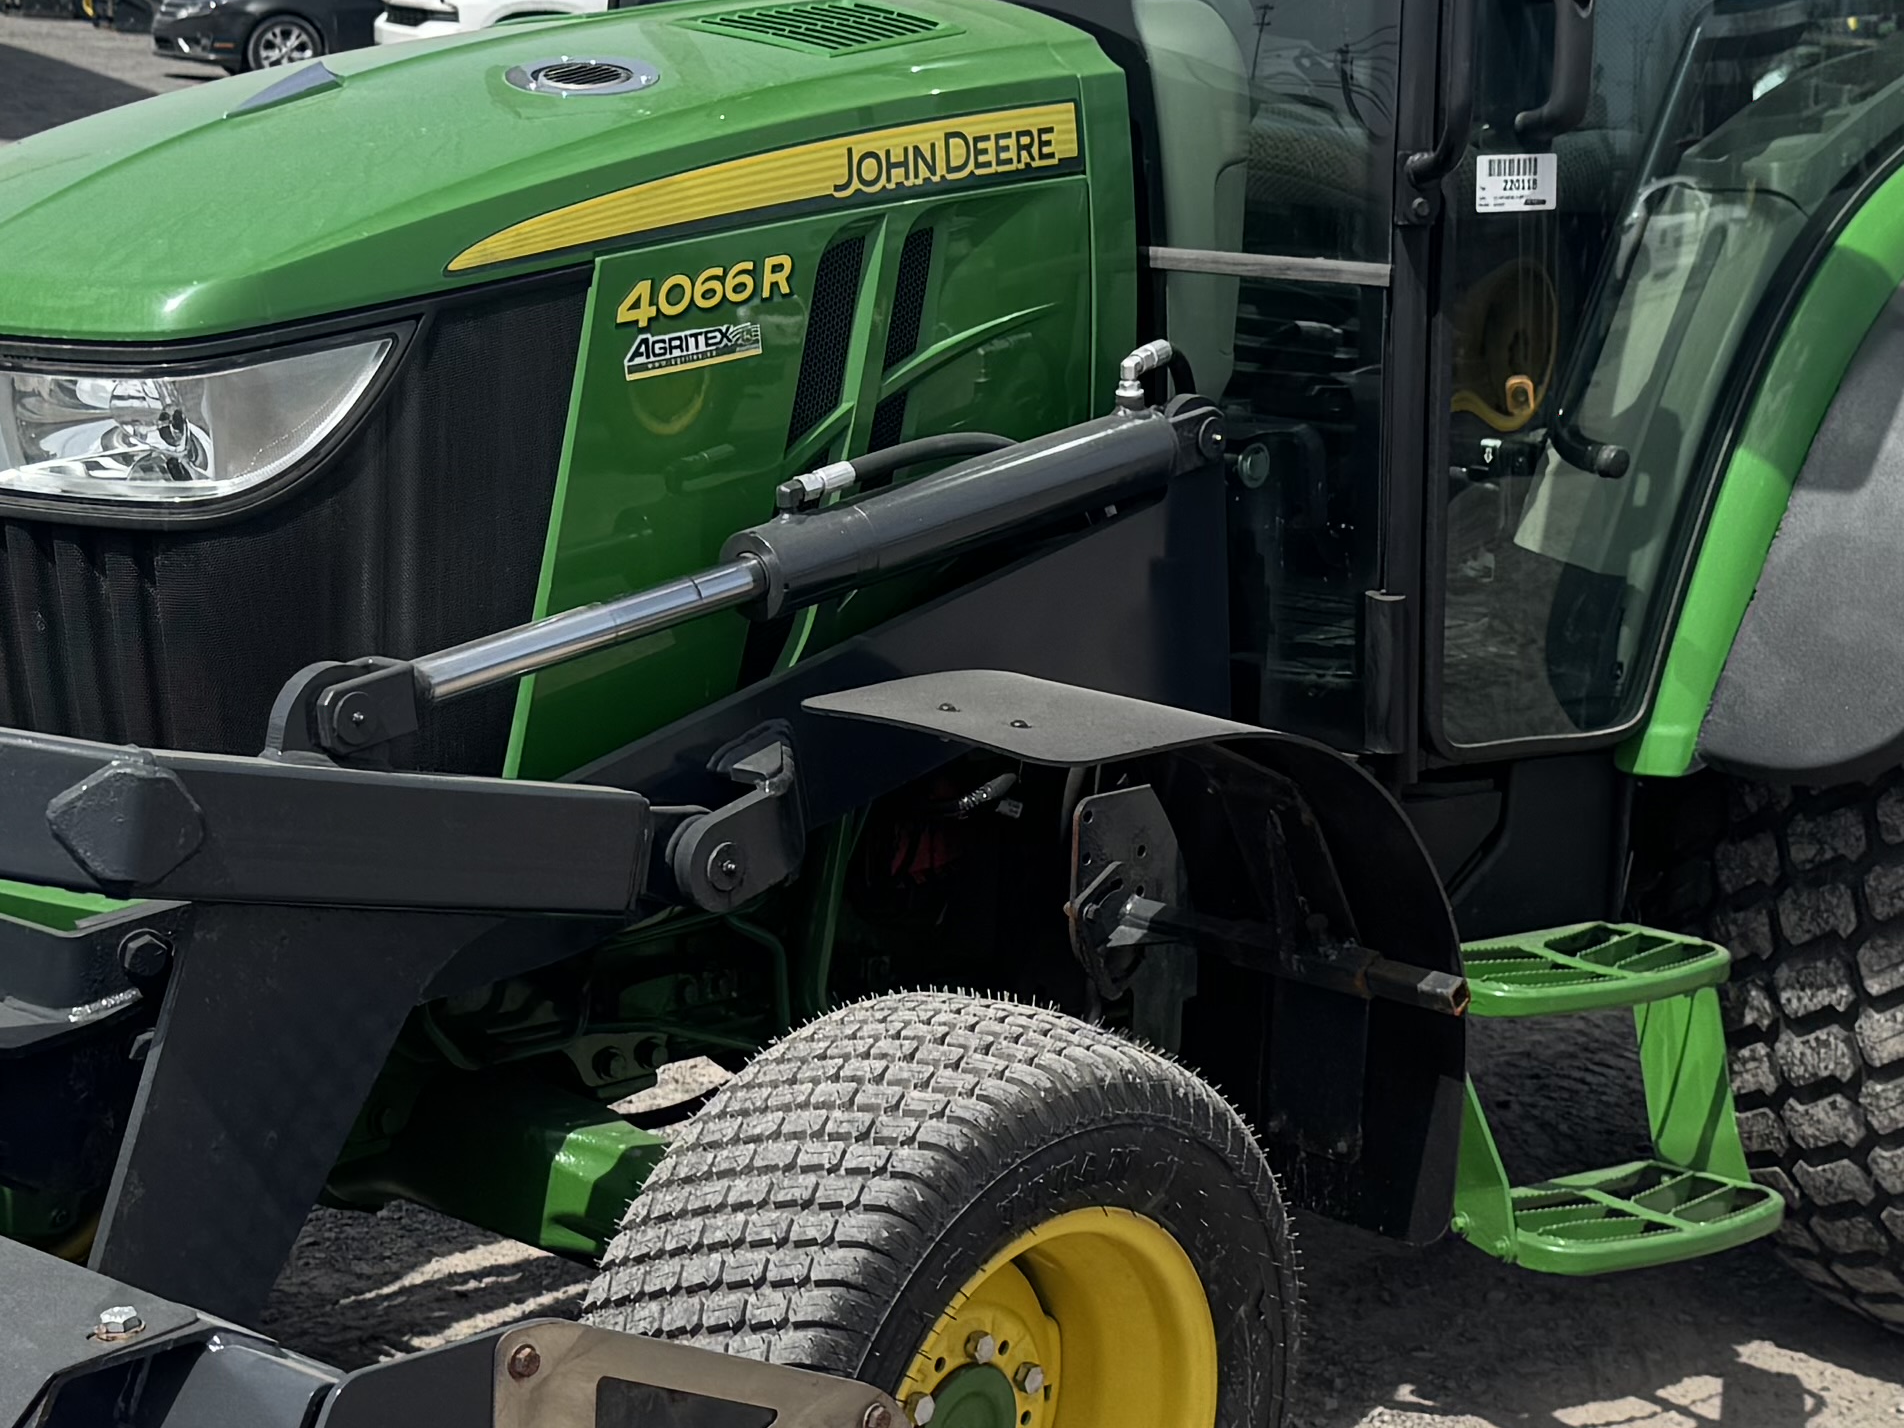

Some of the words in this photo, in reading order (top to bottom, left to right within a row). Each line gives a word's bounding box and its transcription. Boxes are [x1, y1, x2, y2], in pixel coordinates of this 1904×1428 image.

[833, 146, 938, 193] JOHN
[944, 126, 1056, 174] DEERE
[627, 328, 733, 363] AGRITEX
